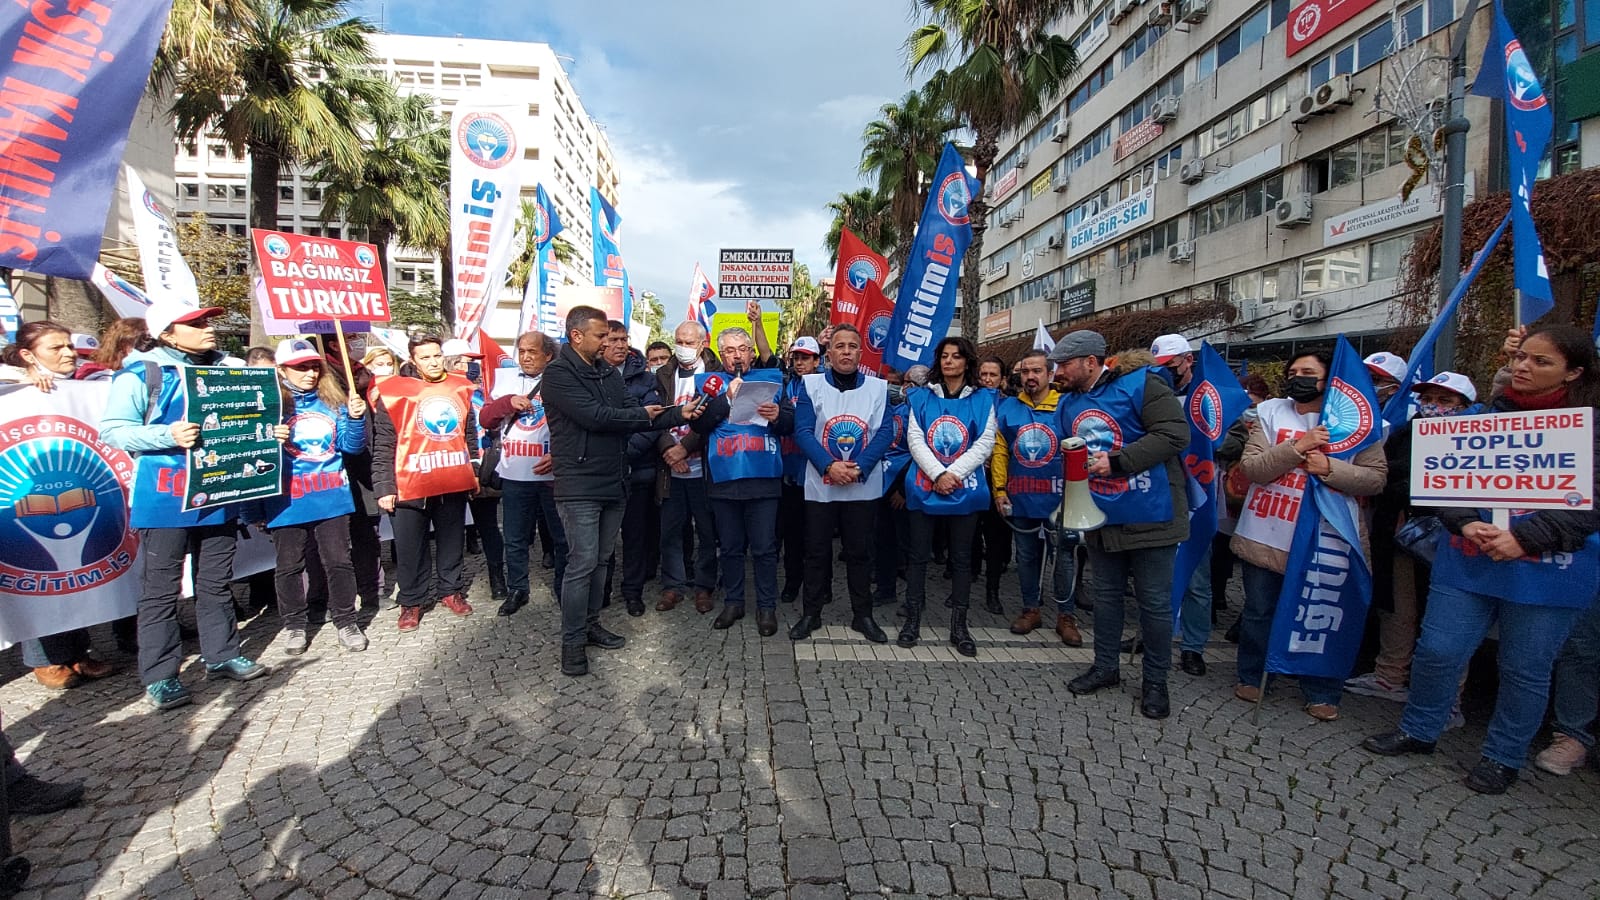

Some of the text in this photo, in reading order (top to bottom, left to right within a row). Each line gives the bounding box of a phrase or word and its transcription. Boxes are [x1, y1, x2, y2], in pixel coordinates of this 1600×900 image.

[301, 241, 339, 259] TAM
[722, 250, 791, 262] EMEKLİLİKTE
[270, 258, 372, 283] BAĞIMSIZ
[761, 264, 789, 273] YAŞAM
[722, 274, 737, 283] HER
[272, 281, 385, 316] TÜRKİYE
[721, 285, 790, 298] HAKKIDIR
[897, 233, 957, 361] Eğitimiş
[1419, 413, 1584, 436] ÜNİVERSİTELERDE
[1451, 433, 1543, 450] TOPLU
[1424, 453, 1576, 473] SÖZLEŞME
[34, 480, 74, 492] 2005
[1423, 472, 1577, 490] İSTİYORUZ
[1247, 487, 1301, 522] Eğiti
[0, 550, 131, 592] EĞİTİM-İŞ
